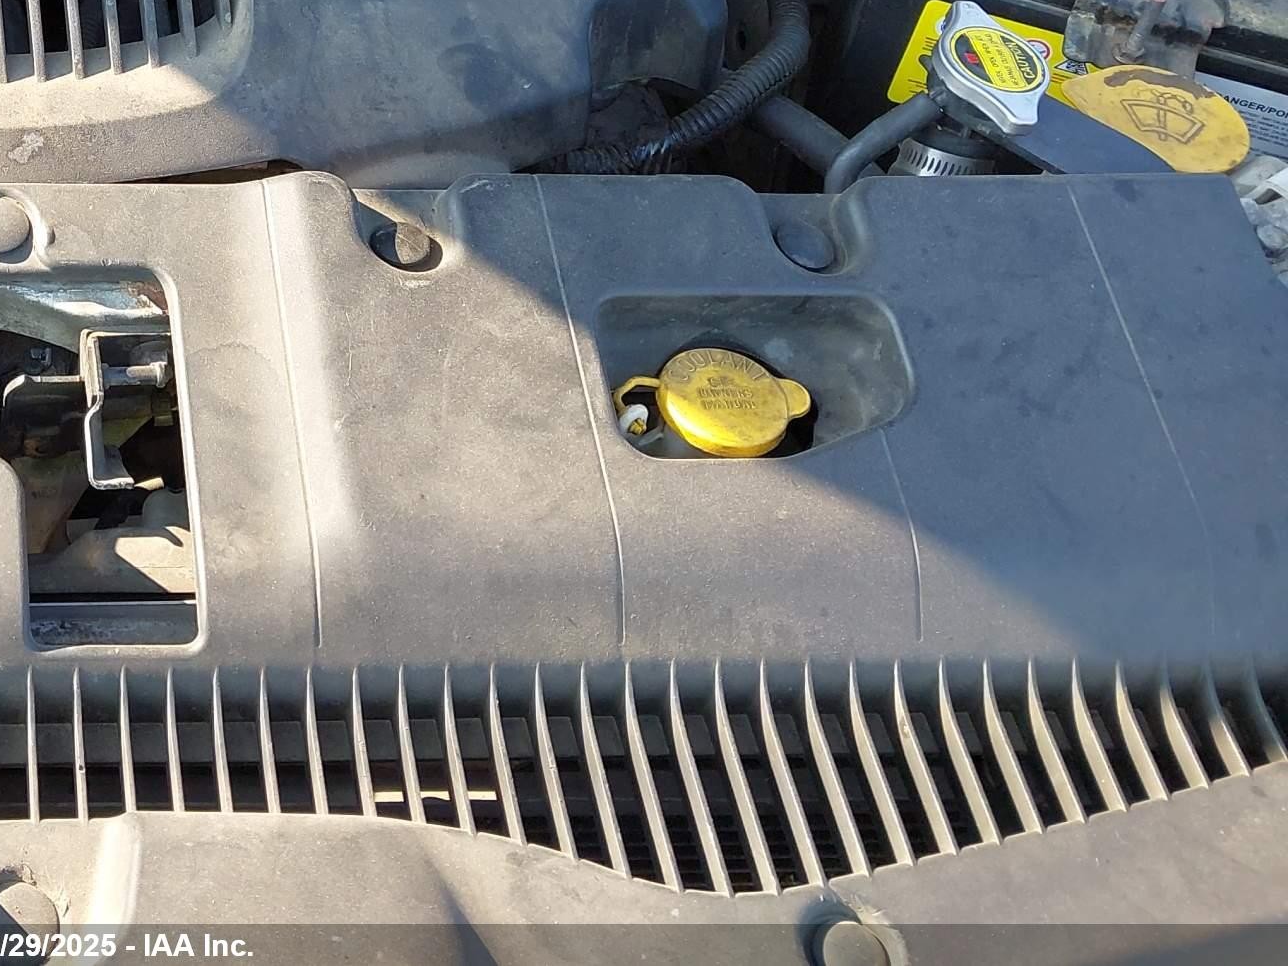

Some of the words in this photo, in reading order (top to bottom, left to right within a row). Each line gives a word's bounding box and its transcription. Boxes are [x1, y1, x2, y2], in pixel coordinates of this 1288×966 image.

[1005, 39, 1036, 79] CAUTION
[1218, 91, 1288, 119] ANGER/PO
[667, 349, 772, 381] COOLANT
